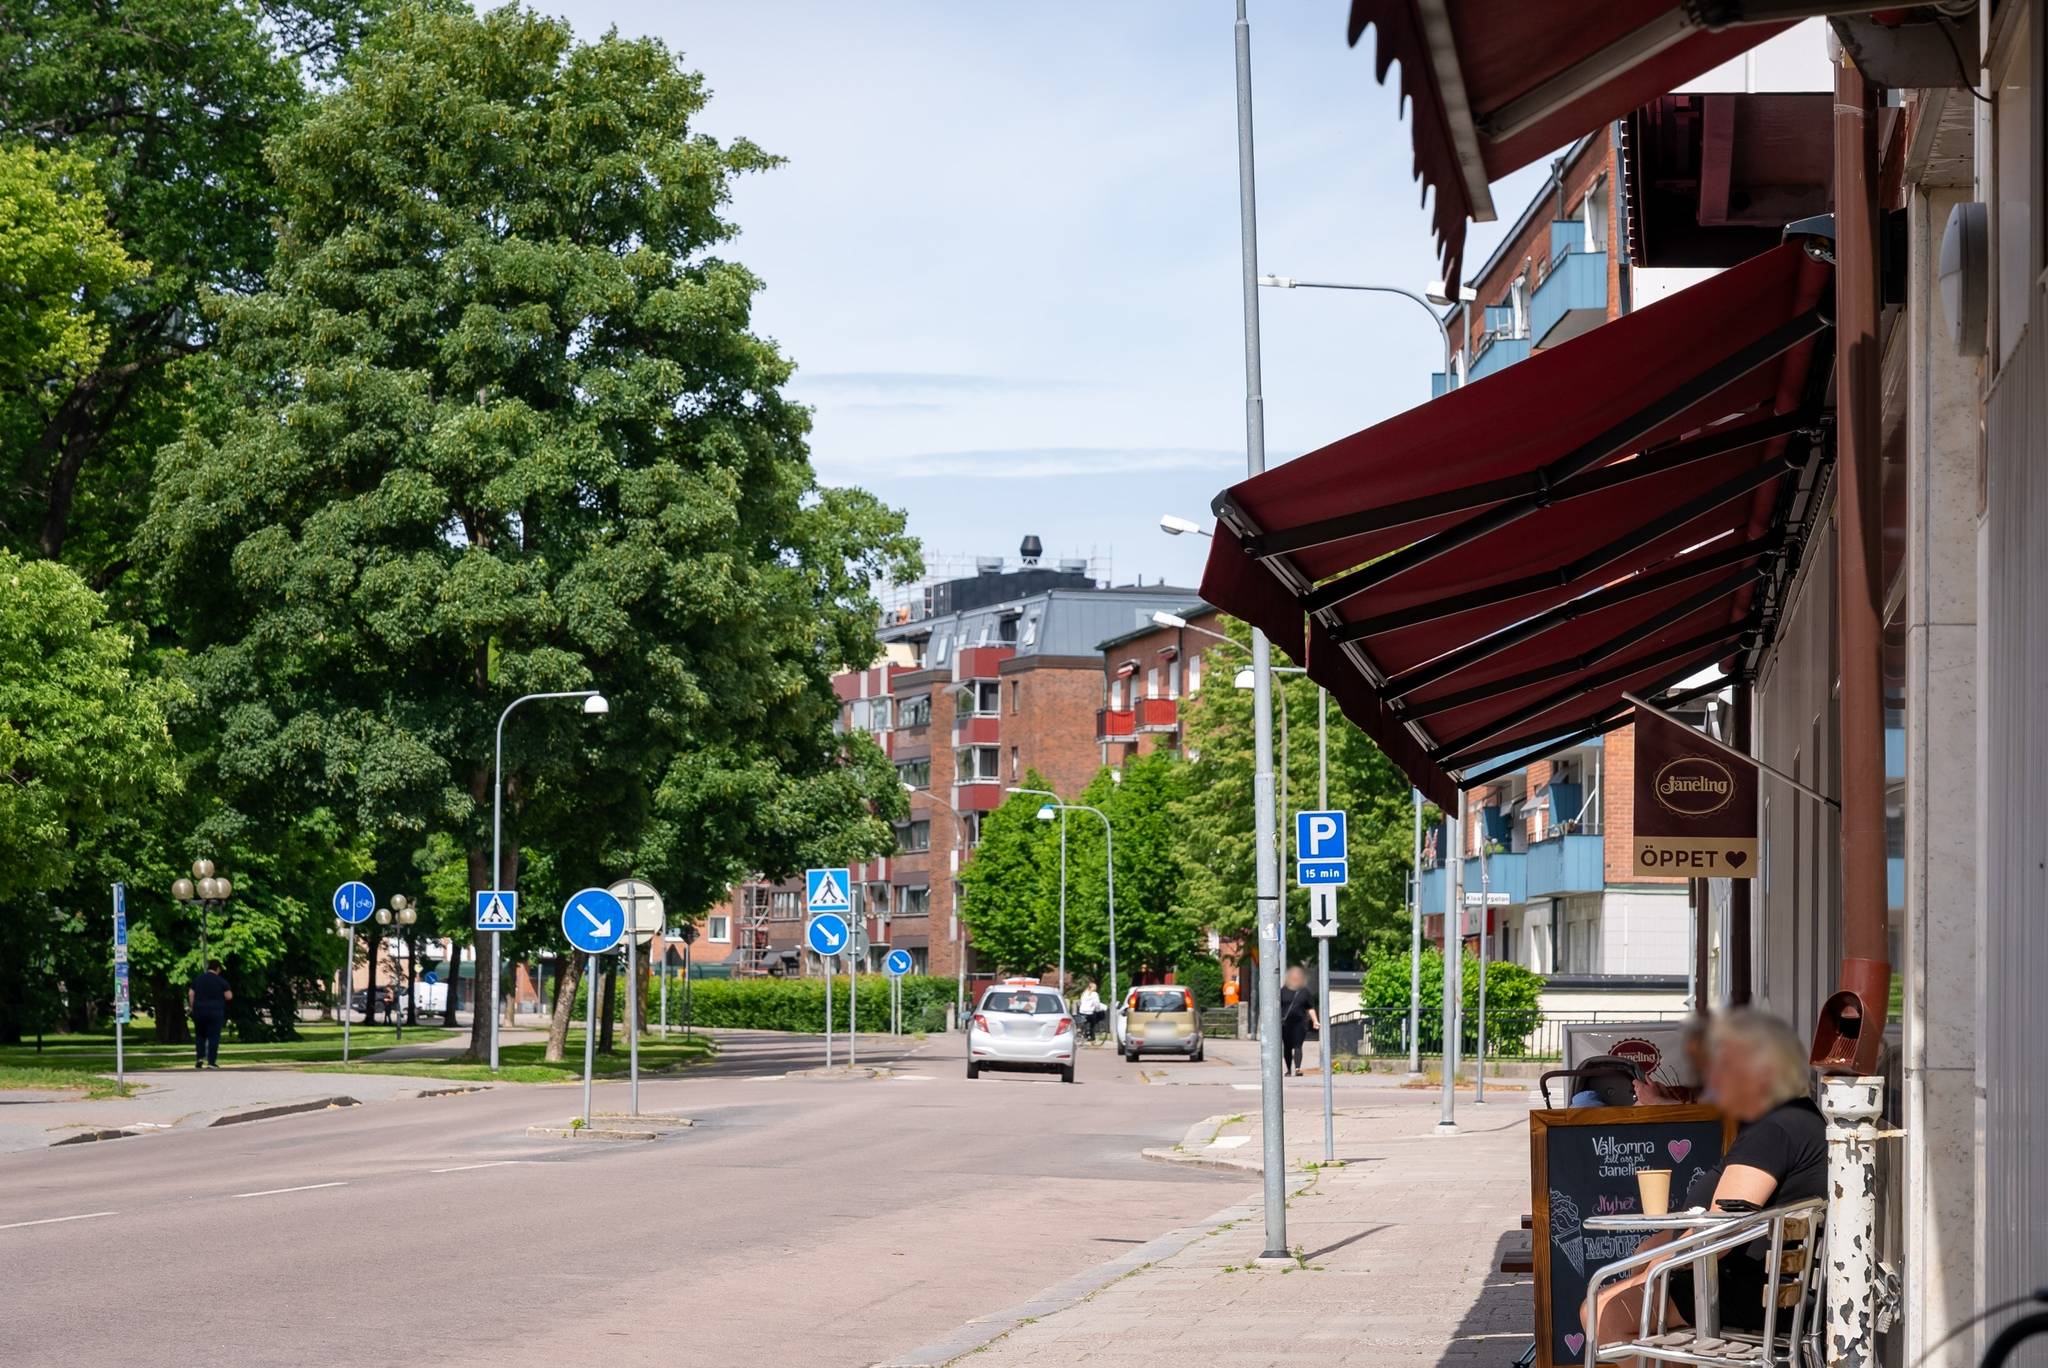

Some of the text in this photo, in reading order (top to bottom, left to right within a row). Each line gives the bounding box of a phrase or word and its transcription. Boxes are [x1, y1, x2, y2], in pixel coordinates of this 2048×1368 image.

[1310, 816, 1337, 855] P
[1640, 845, 1718, 867] ÖPPET
[1305, 868, 1340, 878] 15 min
[1592, 1136, 1655, 1156] Välkomna
